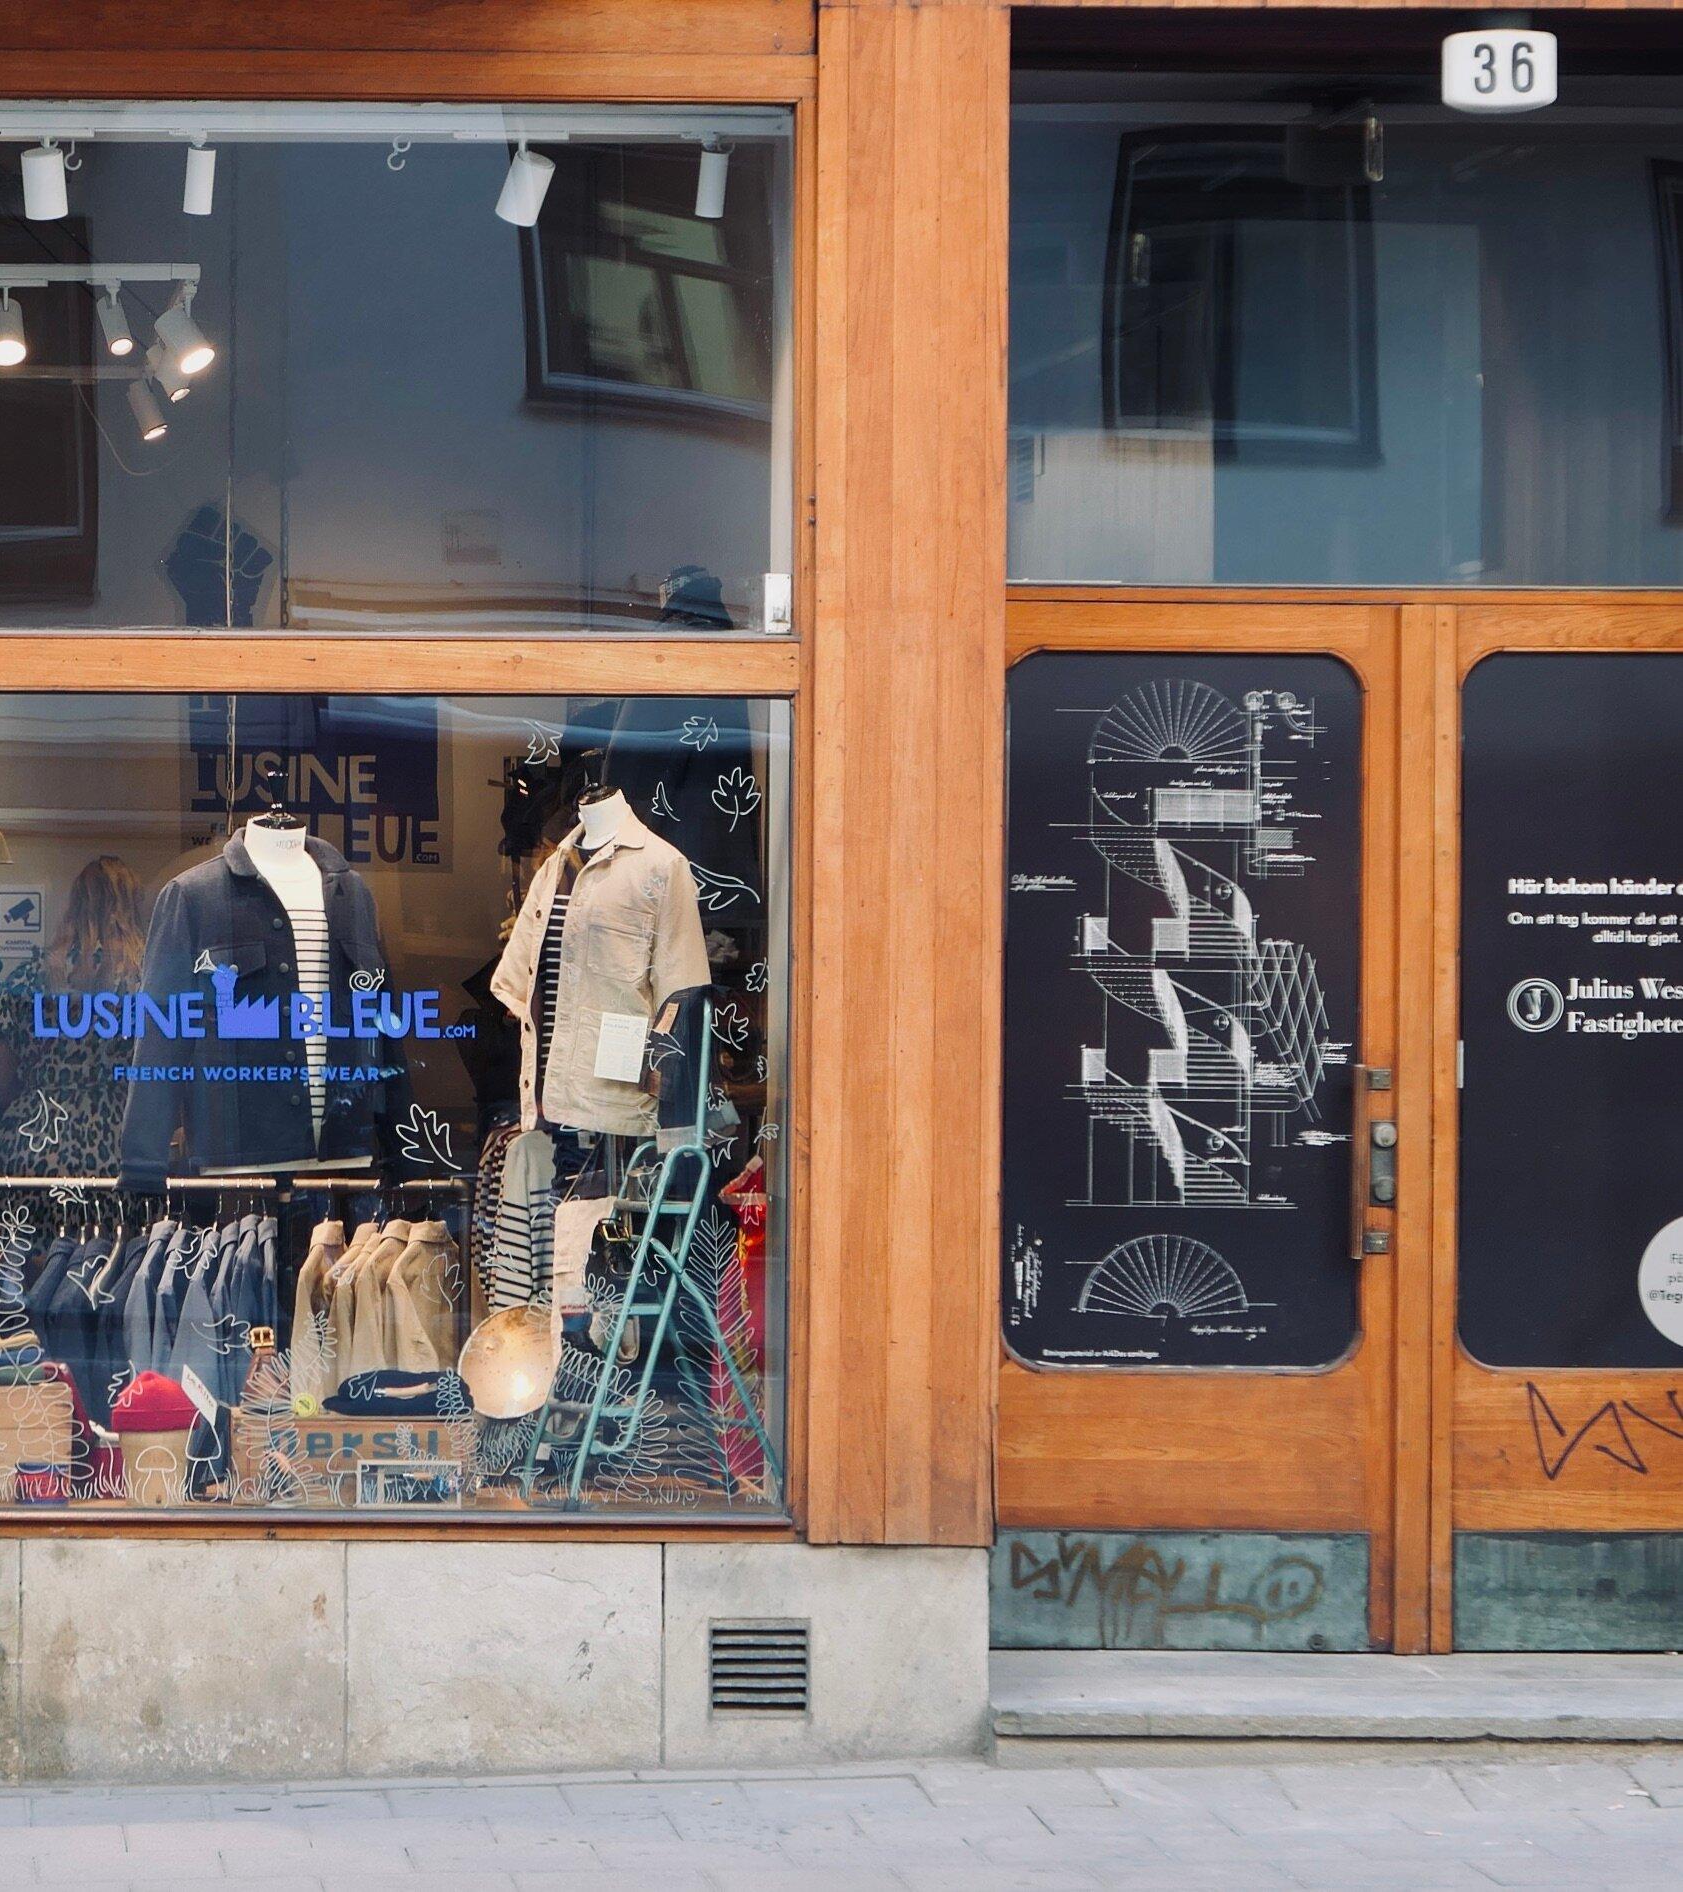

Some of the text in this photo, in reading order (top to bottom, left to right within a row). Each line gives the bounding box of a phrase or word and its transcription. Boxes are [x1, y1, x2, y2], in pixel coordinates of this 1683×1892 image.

[1474, 42, 1534, 94] 36
[1508, 877, 1544, 895] Här
[1545, 877, 1608, 895] bakom
[1609, 877, 1676, 895] händer
[1507, 911, 1534, 925] Om
[1556, 913, 1579, 928] tag
[1581, 911, 1632, 925] kommer
[1634, 911, 1657, 925] det
[1592, 930, 1624, 943] alltid
[1625, 930, 1647, 943] har
[1566, 977, 1635, 1000] Julius
[113, 1065, 380, 1081] FRENCH WORKER'S WEAR
